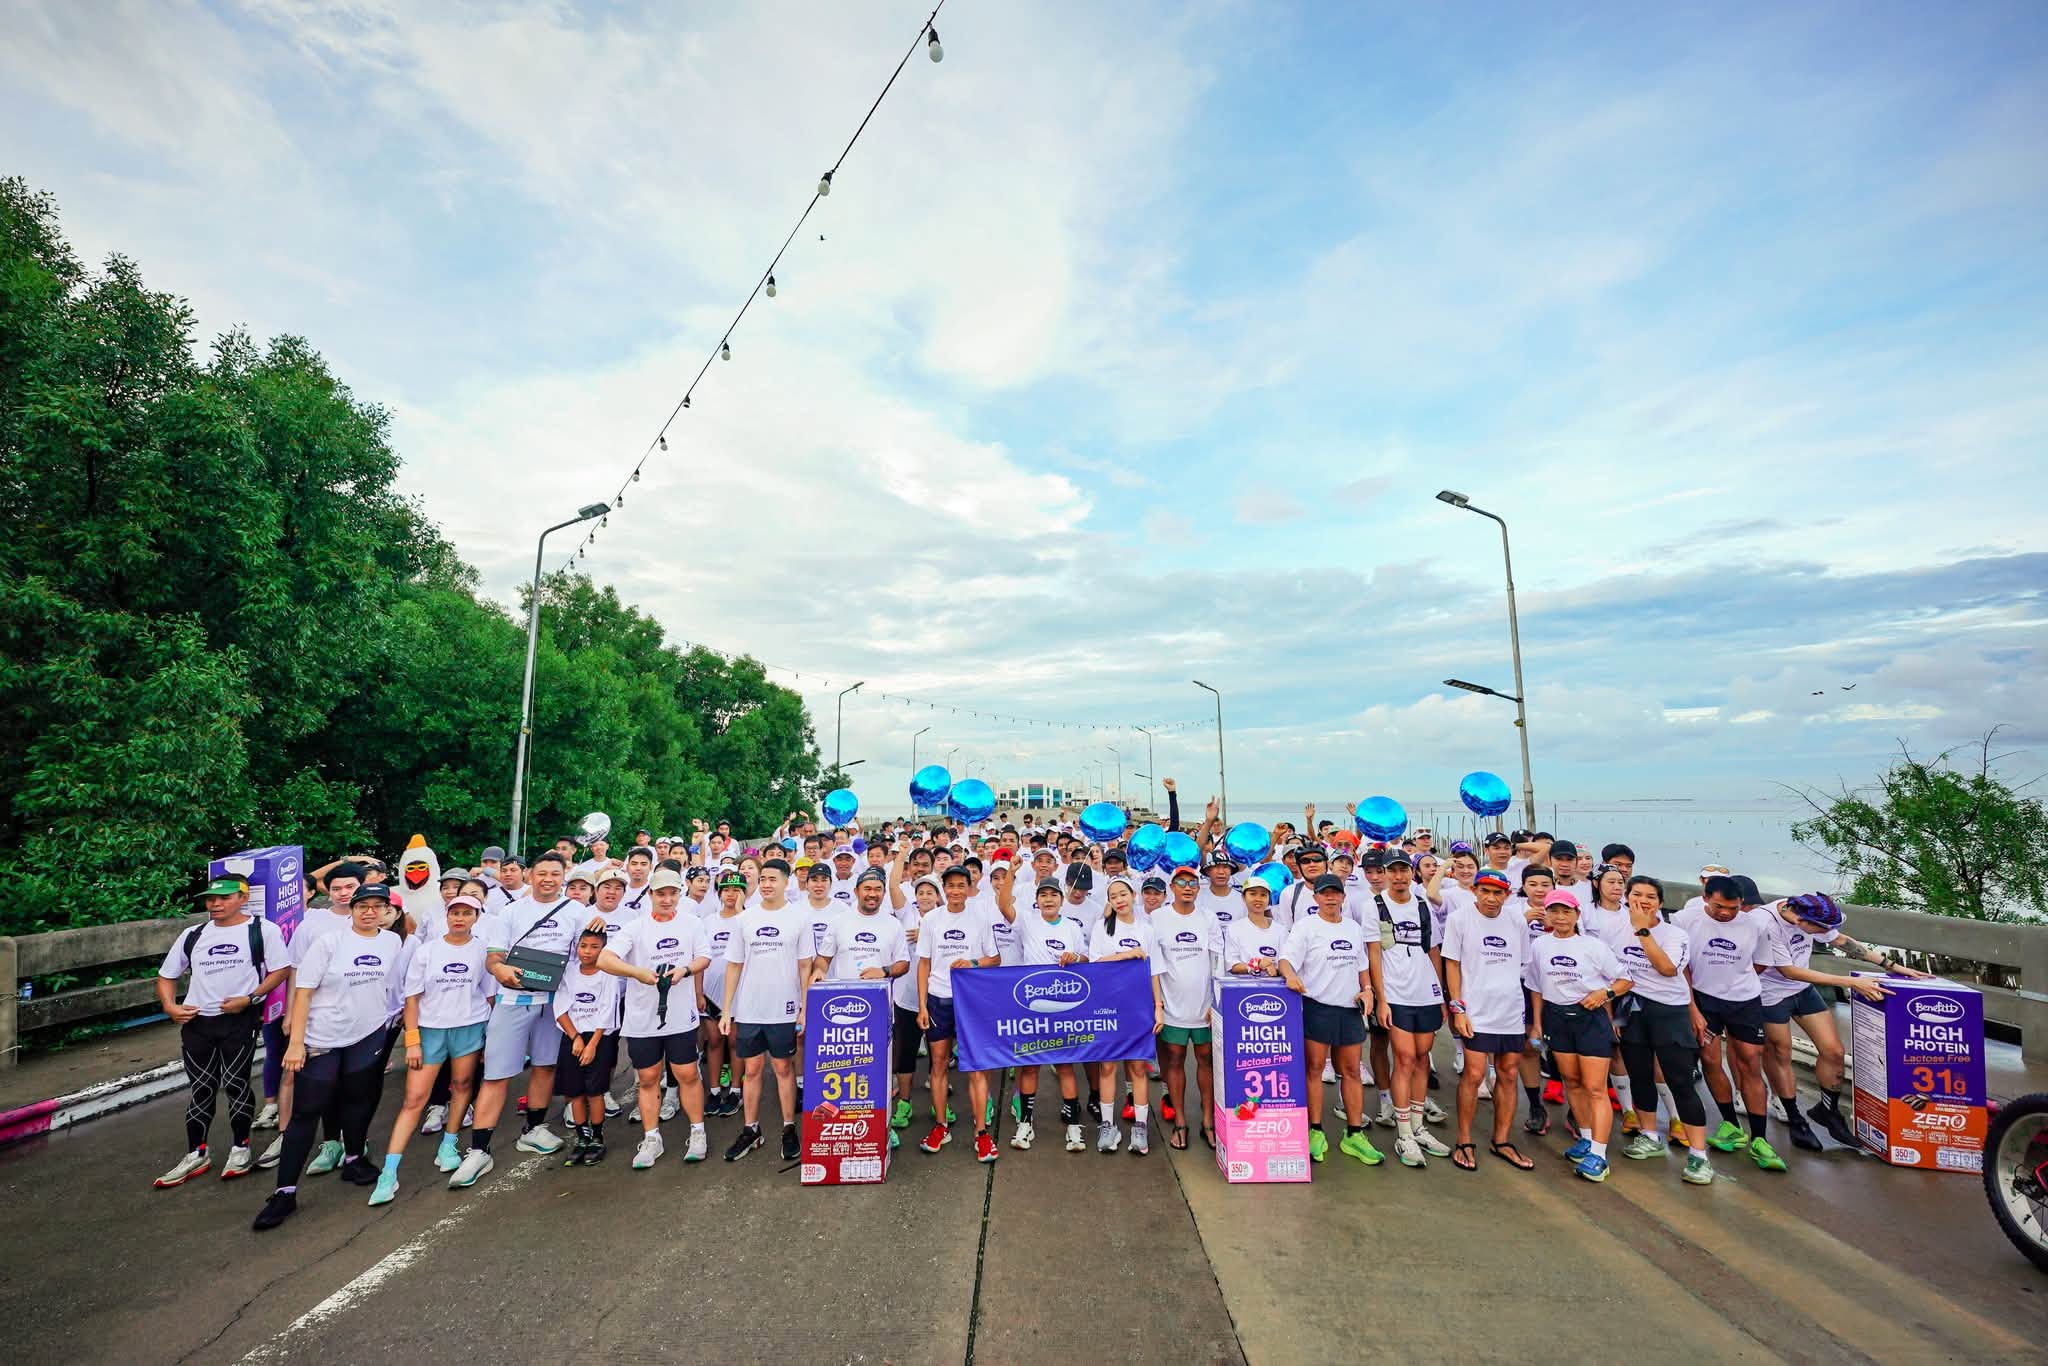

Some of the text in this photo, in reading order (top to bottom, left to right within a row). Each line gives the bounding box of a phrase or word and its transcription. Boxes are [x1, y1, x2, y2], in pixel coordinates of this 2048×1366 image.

[279, 880, 298, 900] HIGH
[1024, 979, 1082, 1000] Benefitt
[824, 1027, 868, 1043] HIGH
[997, 1018, 1118, 1036] HIGH PROTEIN
[1241, 1026, 1286, 1040] HIGH
[1910, 1024, 1963, 1041] HIGH
[818, 1044, 873, 1056] PROTEIN
[1014, 1033, 1095, 1054] Lactose Free
[1237, 1042, 1291, 1054] PROTEIN
[1904, 1039, 1969, 1054] PROTEIN
[816, 1056, 874, 1070] Lactose Free
[1236, 1058, 1271, 1067] Lactose
[1903, 1054, 1971, 1063] Lactose Free
[822, 1072, 869, 1100] 31g
[1244, 1071, 1289, 1098] 31g
[1912, 1066, 1966, 1095] 31g
[821, 1119, 867, 1136] ZERO
[1246, 1118, 1290, 1134] ZERO
[1912, 1112, 1967, 1129] ZERO
[1895, 1148, 1908, 1158] 350
[804, 1166, 816, 1176] 350
[1232, 1163, 1242, 1173] 350
